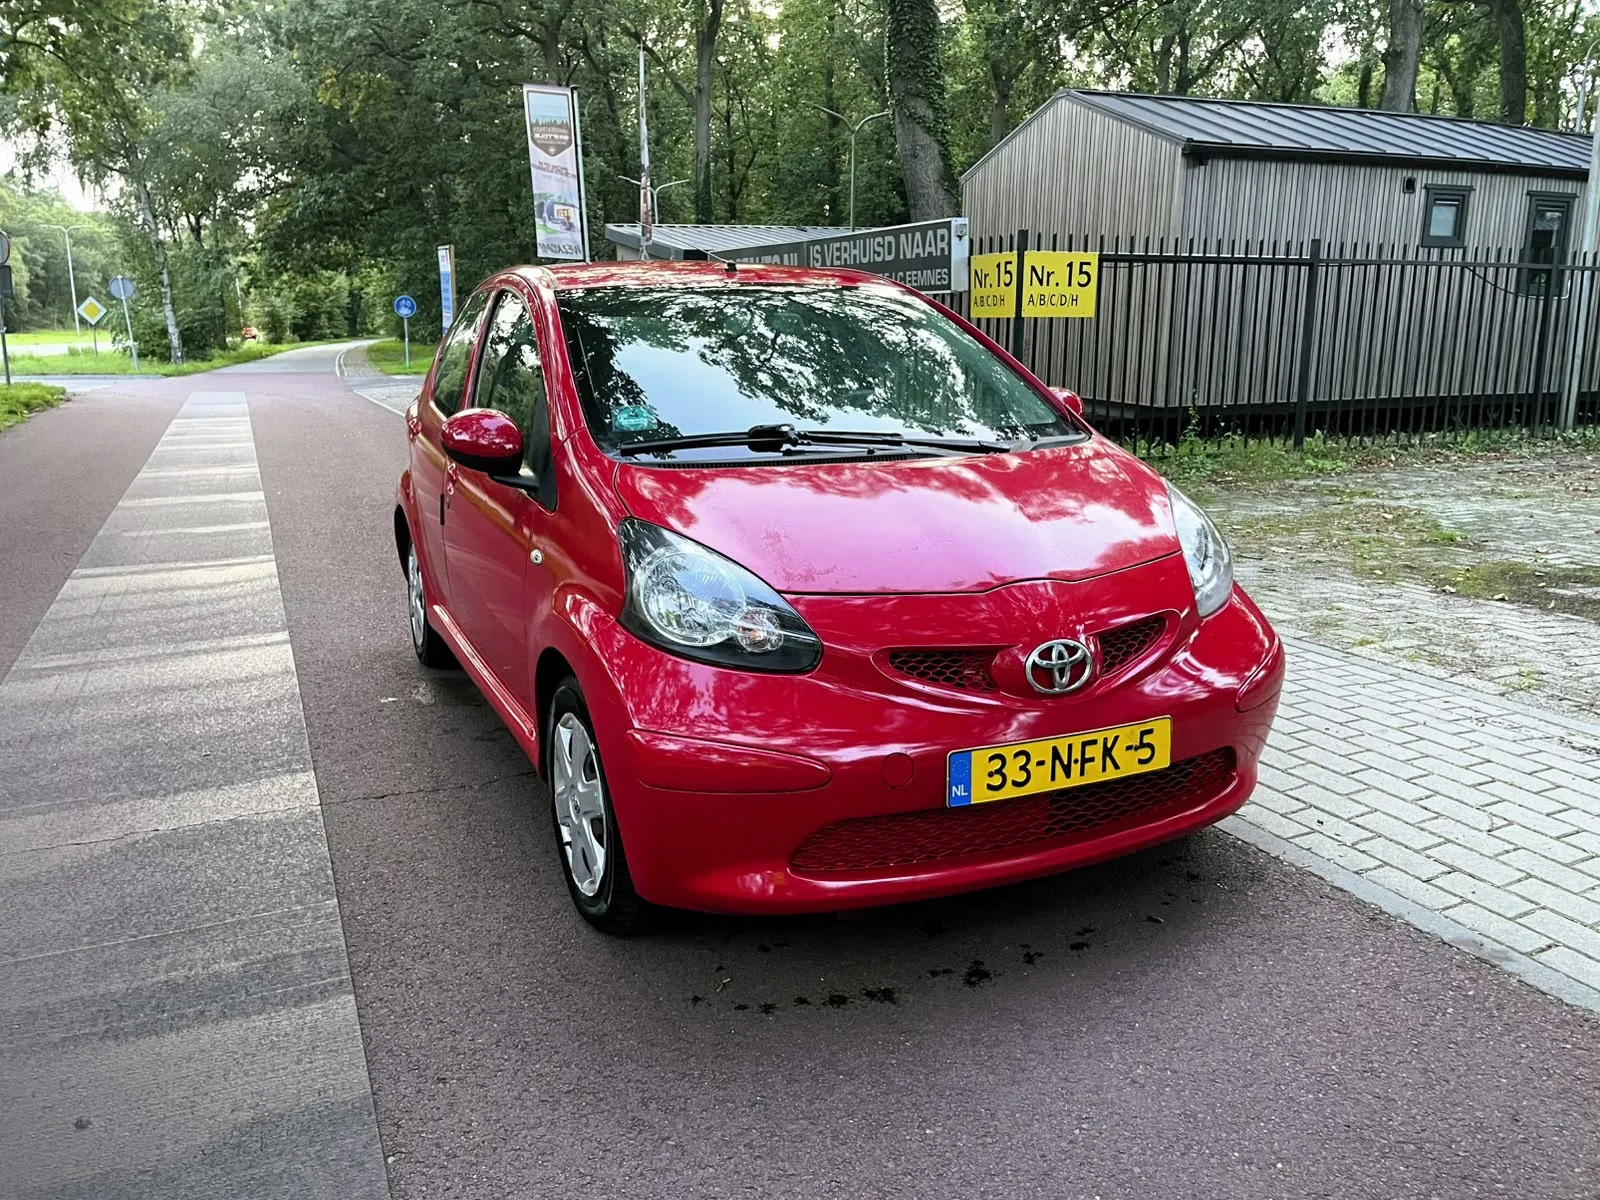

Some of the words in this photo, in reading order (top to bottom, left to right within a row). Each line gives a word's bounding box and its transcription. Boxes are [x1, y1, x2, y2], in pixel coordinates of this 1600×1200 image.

[810, 245, 821, 268] IS
[824, 235, 895, 266] VERHUISD
[900, 228, 949, 259] NAAR
[906, 268, 949, 287] EEMNES
[974, 268, 992, 289] Nr.
[996, 261, 1013, 287] 15
[1029, 265, 1059, 287] Nr.
[1066, 261, 1092, 288] 15
[1027, 293, 1079, 307] A/B/C/D/H
[985, 728, 1156, 792] 33-NFK-5
[951, 785, 968, 797] NL
